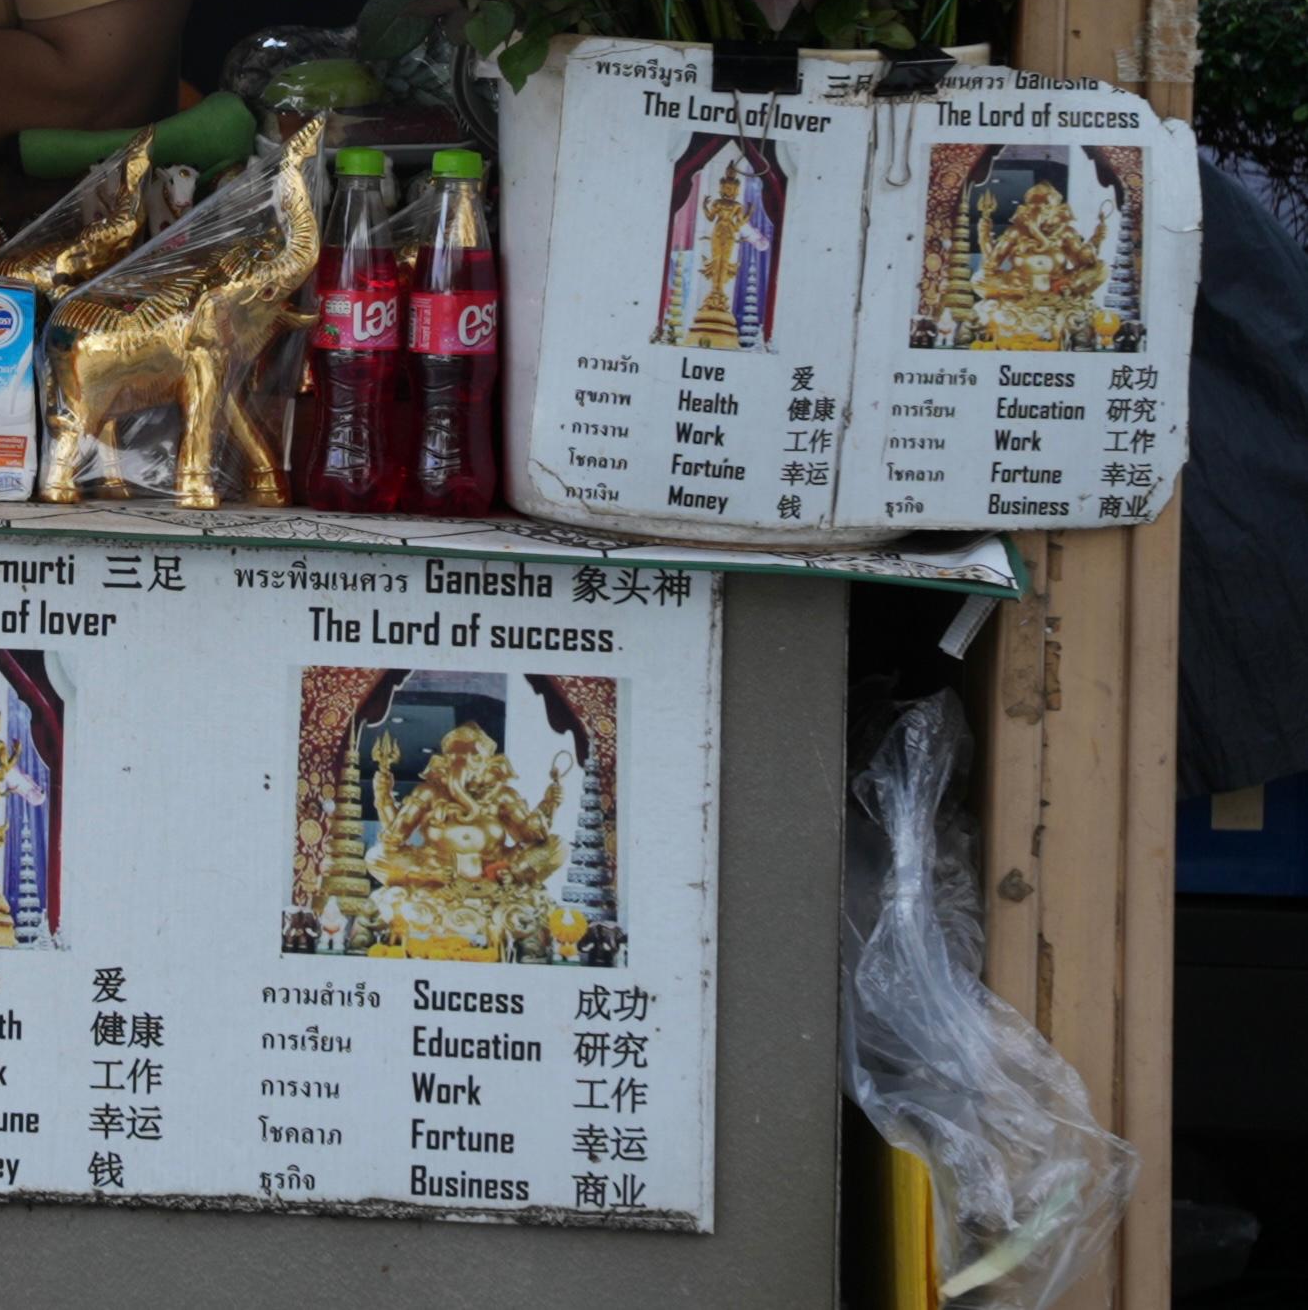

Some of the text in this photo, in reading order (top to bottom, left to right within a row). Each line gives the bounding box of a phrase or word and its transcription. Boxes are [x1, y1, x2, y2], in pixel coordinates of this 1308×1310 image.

[642, 90, 831, 132] The Lord of lover
[938, 101, 1140, 129] The Lord of success
[680, 356, 726, 382] Love
[998, 364, 1076, 388] Success
[677, 389, 739, 416] Health
[996, 396, 1086, 421] Education
[675, 421, 725, 447] Work
[994, 429, 1042, 452] Work
[671, 454, 745, 480] Fortune
[990, 461, 1063, 485] Fortune
[667, 484, 729, 515] Money
[987, 493, 1070, 517] Business
[102, 553, 187, 592] 三足
[425, 560, 552, 598] Ganesha
[572, 564, 692, 606] 象头神
[1, 598, 31, 635] of
[39, 599, 117, 637] lover
[308, 606, 361, 643] The
[372, 608, 441, 647] Lord
[451, 612, 482, 648] of
[91, 966, 127, 1003] 爱
[413, 979, 525, 1015] Success
[574, 983, 650, 1022] 成功
[89, 1010, 165, 1049] 健康
[412, 1025, 542, 1062] Education
[573, 1030, 649, 1069] 研究
[89, 1057, 164, 1095] 工作
[411, 1071, 482, 1106] Work
[572, 1076, 649, 1115] 工作
[88, 1102, 163, 1141] 幸运
[411, 1118, 515, 1155] Fortune
[571, 1123, 648, 1164] 幸运
[87, 1150, 125, 1189] 钱
[410, 1164, 530, 1202] Business
[572, 1172, 647, 1210] 商业
